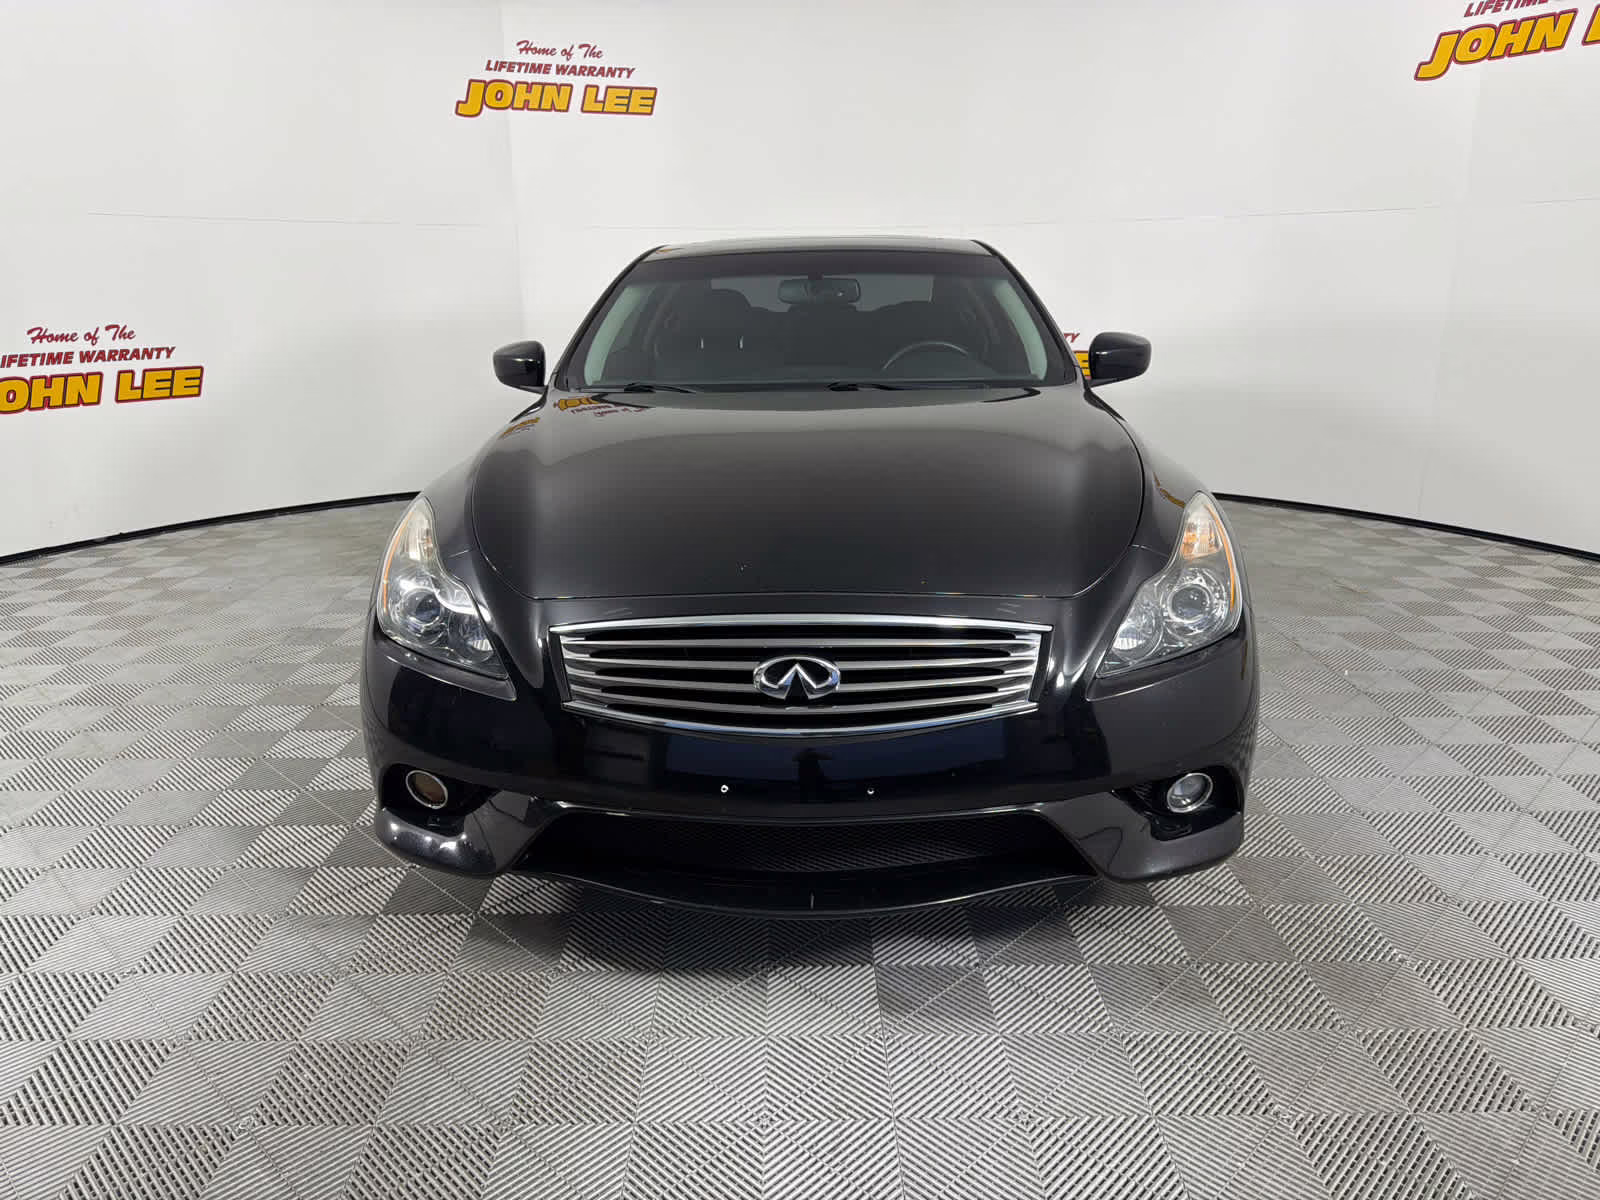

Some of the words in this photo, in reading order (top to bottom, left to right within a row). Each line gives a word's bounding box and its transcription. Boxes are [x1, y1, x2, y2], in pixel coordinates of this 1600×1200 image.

[1463, 0, 1549, 17] LIFETI
[516, 40, 557, 56] Home
[561, 45, 574, 61] of
[578, 44, 604, 59] The
[1414, 8, 1578, 81] JOHN
[485, 60, 552, 75] LIFETIME
[555, 63, 636, 79] WARRANTY
[455, 79, 573, 117] JOHN
[581, 84, 657, 115] LEE
[26, 326, 79, 344] Home
[83, 327, 100, 346] of
[104, 324, 136, 341] The
[0, 352, 74, 368] IFETIME
[79, 346, 176, 364] WARRANTY
[0, 371, 103, 414] OHN
[115, 366, 204, 403] LEE
